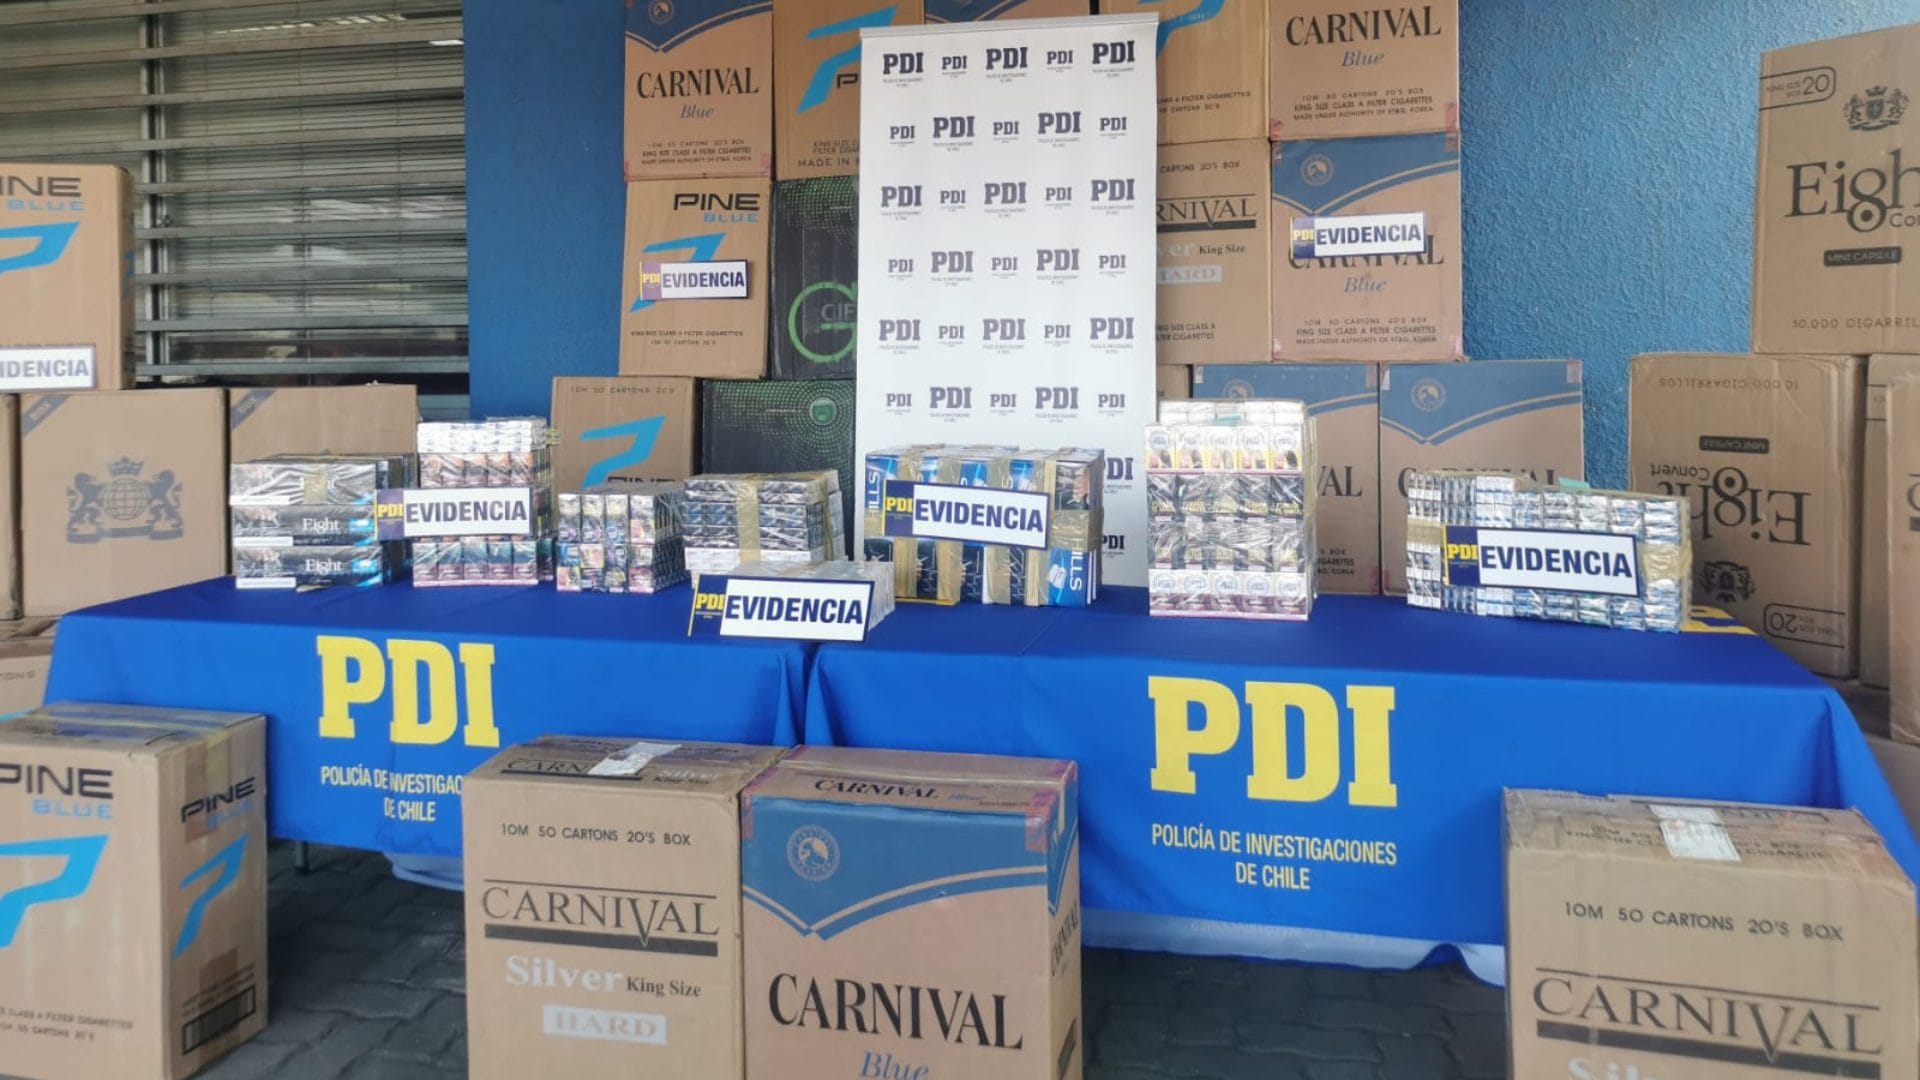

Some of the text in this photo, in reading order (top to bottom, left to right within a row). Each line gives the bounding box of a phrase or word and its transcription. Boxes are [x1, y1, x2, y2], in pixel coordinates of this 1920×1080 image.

[1286, 6, 1441, 46] CARNIVAL
[942, 55, 967, 70] PDI
[986, 46, 1027, 70] PDI
[1047, 50, 1073, 65] PDI
[1093, 40, 1134, 64] PDI
[1342, 50, 1384, 66] Blue
[883, 52, 923, 75] PDI
[636, 67, 759, 98] CARNIVAL
[1802, 74, 1830, 95] 20
[1342, 91, 1377, 99] CARTONS
[681, 104, 714, 118] Blue
[890, 126, 915, 139] PDI
[933, 116, 974, 138] PDI
[993, 121, 1019, 135] PDI
[1038, 112, 1080, 134] PDI
[1100, 117, 1127, 131] PDI
[1160, 164, 1194, 173] CARTONS
[1222, 161, 1240, 169] BOX
[881, 186, 922, 207] PDI
[940, 190, 966, 204] PDI
[984, 182, 1026, 205] PDI
[1046, 187, 1072, 201] PDI
[1091, 179, 1134, 201] PDI
[1784, 148, 1920, 232] Eigh
[7, 200, 85, 210] BLUE
[674, 194, 761, 210] PINE
[704, 213, 759, 223] BLUE
[1156, 199, 1257, 229] RNIVAL
[1294, 224, 1421, 245] PDI EVIDENCIA
[1037, 249, 1079, 271] PDI
[1200, 244, 1223, 256] King
[1226, 244, 1246, 253] Size
[889, 259, 913, 272] PDI
[932, 251, 973, 273] PDI
[992, 257, 1018, 271] PDI
[1099, 255, 1126, 269] PDI
[643, 272, 745, 288] PDI EVIDENCIA
[1344, 277, 1386, 292] Blue
[879, 319, 920, 341] PDI
[939, 326, 964, 339] PDI
[983, 319, 1025, 340] PDI
[1044, 325, 1071, 338] PDI
[1090, 317, 1134, 340] PDI
[1846, 317, 1920, 328] CIGARRIL
[1173, 332, 1214, 340] CIGARETTES
[0, 360, 88, 377] IDENCIA
[886, 393, 912, 407] PDI
[930, 387, 971, 408] PDI
[990, 394, 1017, 407] PDI
[1035, 387, 1079, 409] PDI
[1098, 394, 1125, 408] PDI
[1106, 456, 1134, 480] DI
[1650, 464, 1710, 481] Convert
[378, 500, 526, 522] PDI EVIDENCIA
[886, 497, 1044, 532] PDI EVIDENCIA
[302, 518, 340, 534] Eight
[305, 558, 342, 574] Eight
[1070, 538, 1082, 591] HILLS
[1448, 544, 1632, 578] PDI EVIDENCIA
[696, 594, 863, 624] PDI EVIDENCIA
[1770, 612, 1797, 633] 20
[316, 635, 500, 748] PDI
[1148, 675, 1397, 807] PDI
[0, 764, 113, 799] PINE
[320, 763, 372, 787] POLICÍA
[374, 769, 388, 789] DE
[815, 778, 939, 798] CARNIVAL
[32, 799, 113, 819] BLUE
[182, 776, 255, 824] PINE
[384, 797, 435, 822] DE CHILE
[502, 824, 691, 846] 10M 50 CARTONS 20'S BOX
[1152, 824, 1397, 865] POLICÍA DE INVESTIGACIONES
[1236, 862, 1310, 890] DE CHILE
[482, 887, 719, 947] CARNIVAL
[1565, 902, 1844, 942] 10M 50 CARTONS 20'S BOX
[505, 955, 701, 997] Silver King Size
[768, 972, 1023, 1050] CARNIVAL
[1534, 977, 1882, 1064] CARNIVAL
[556, 1010, 656, 1036] HARD
[860, 1050, 930, 1080] Blue
